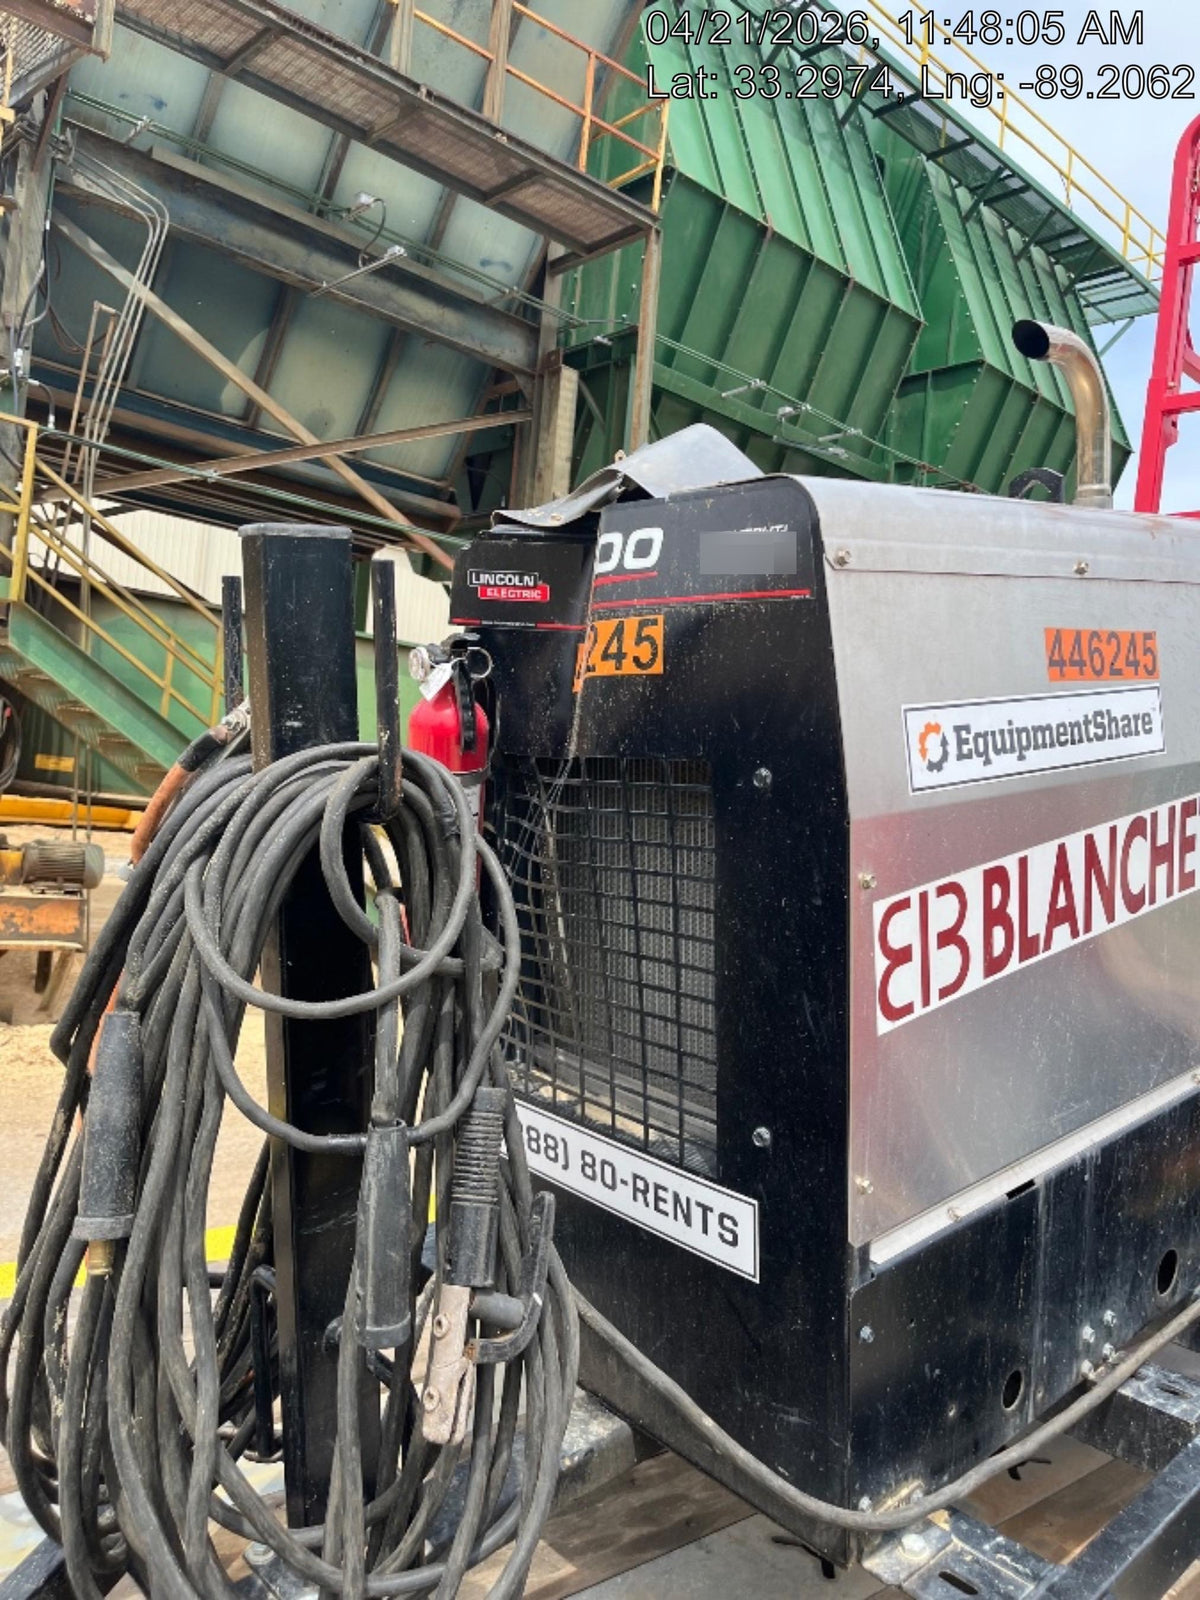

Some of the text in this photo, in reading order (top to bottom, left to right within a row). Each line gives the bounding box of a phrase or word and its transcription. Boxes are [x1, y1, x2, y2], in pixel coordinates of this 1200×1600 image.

[472, 572, 534, 586] LINCOLN
[486, 588, 542, 598] ELECTRIC
[1049, 629, 1157, 677] 446245
[952, 709, 1152, 767] EquipmentShare
[983, 796, 1200, 979] BLANCHE
[521, 1124, 738, 1248] 88) 80-RENTS
